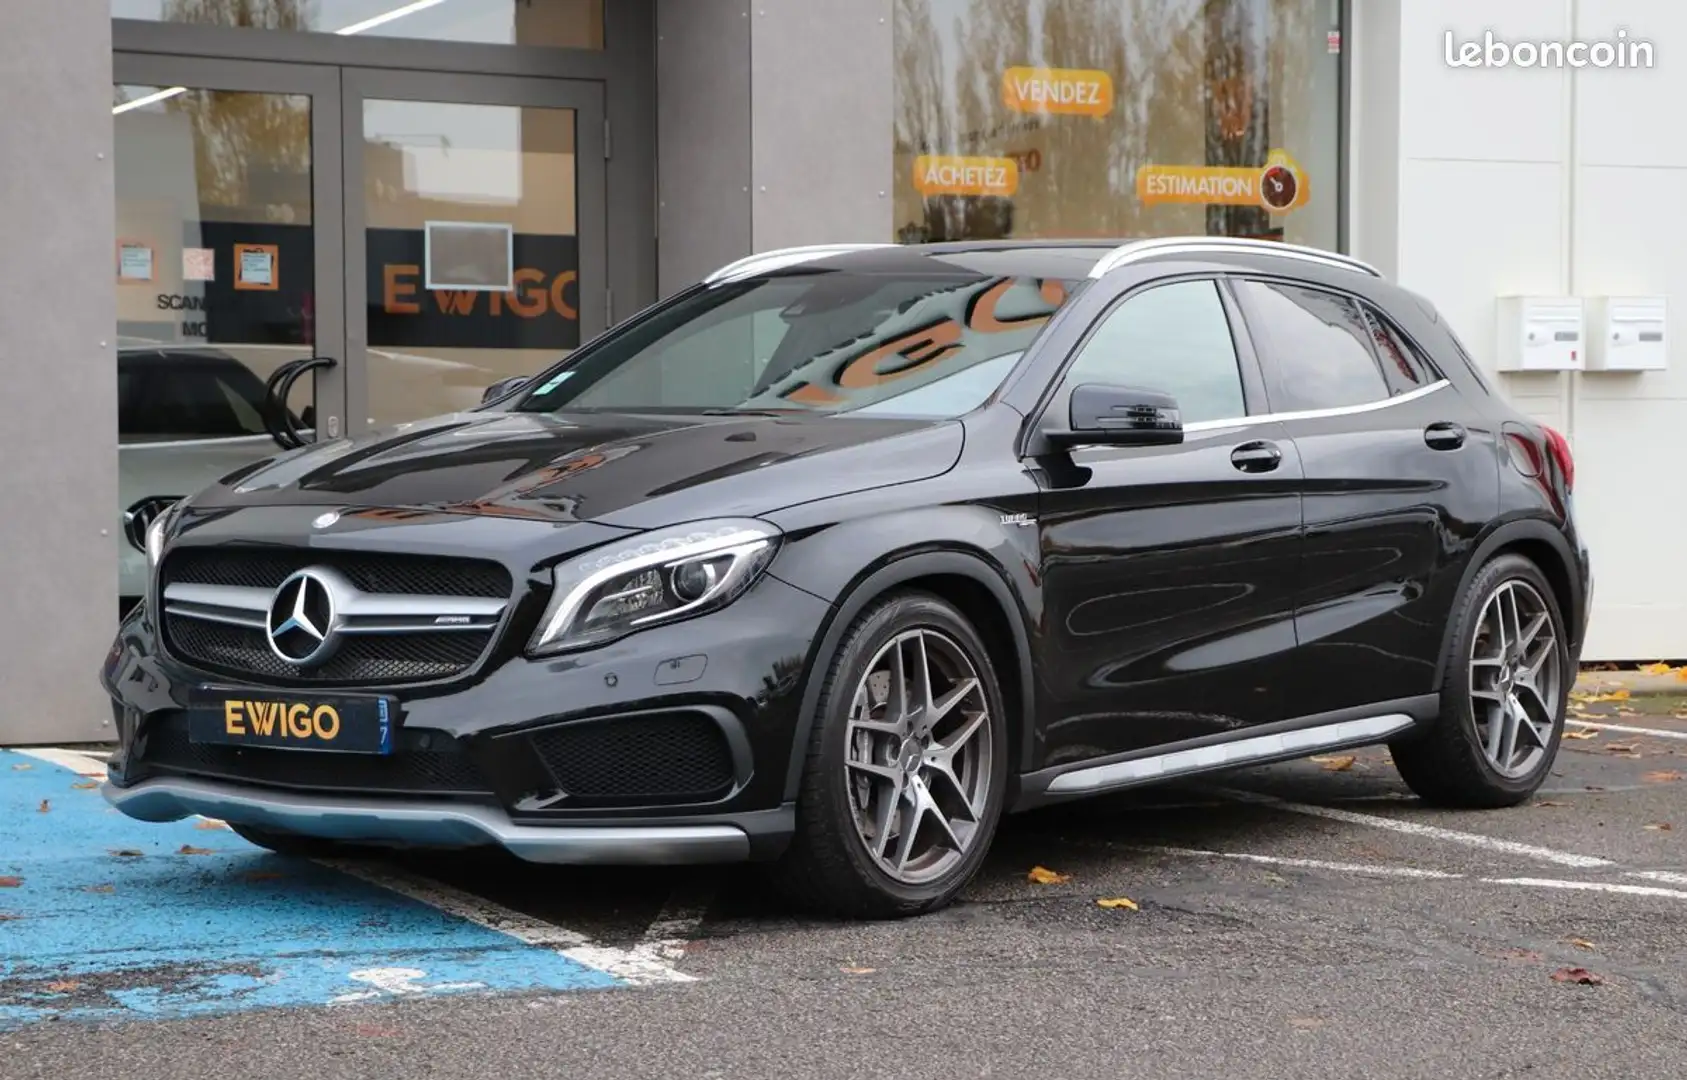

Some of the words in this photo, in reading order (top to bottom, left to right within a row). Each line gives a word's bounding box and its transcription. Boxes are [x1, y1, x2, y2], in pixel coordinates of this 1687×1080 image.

[1015, 80, 1100, 105] VENDEZ
[923, 164, 1008, 188] ACHETEZ
[1146, 174, 1253, 197] ESTIMATION
[224, 699, 340, 740] EWIGO
